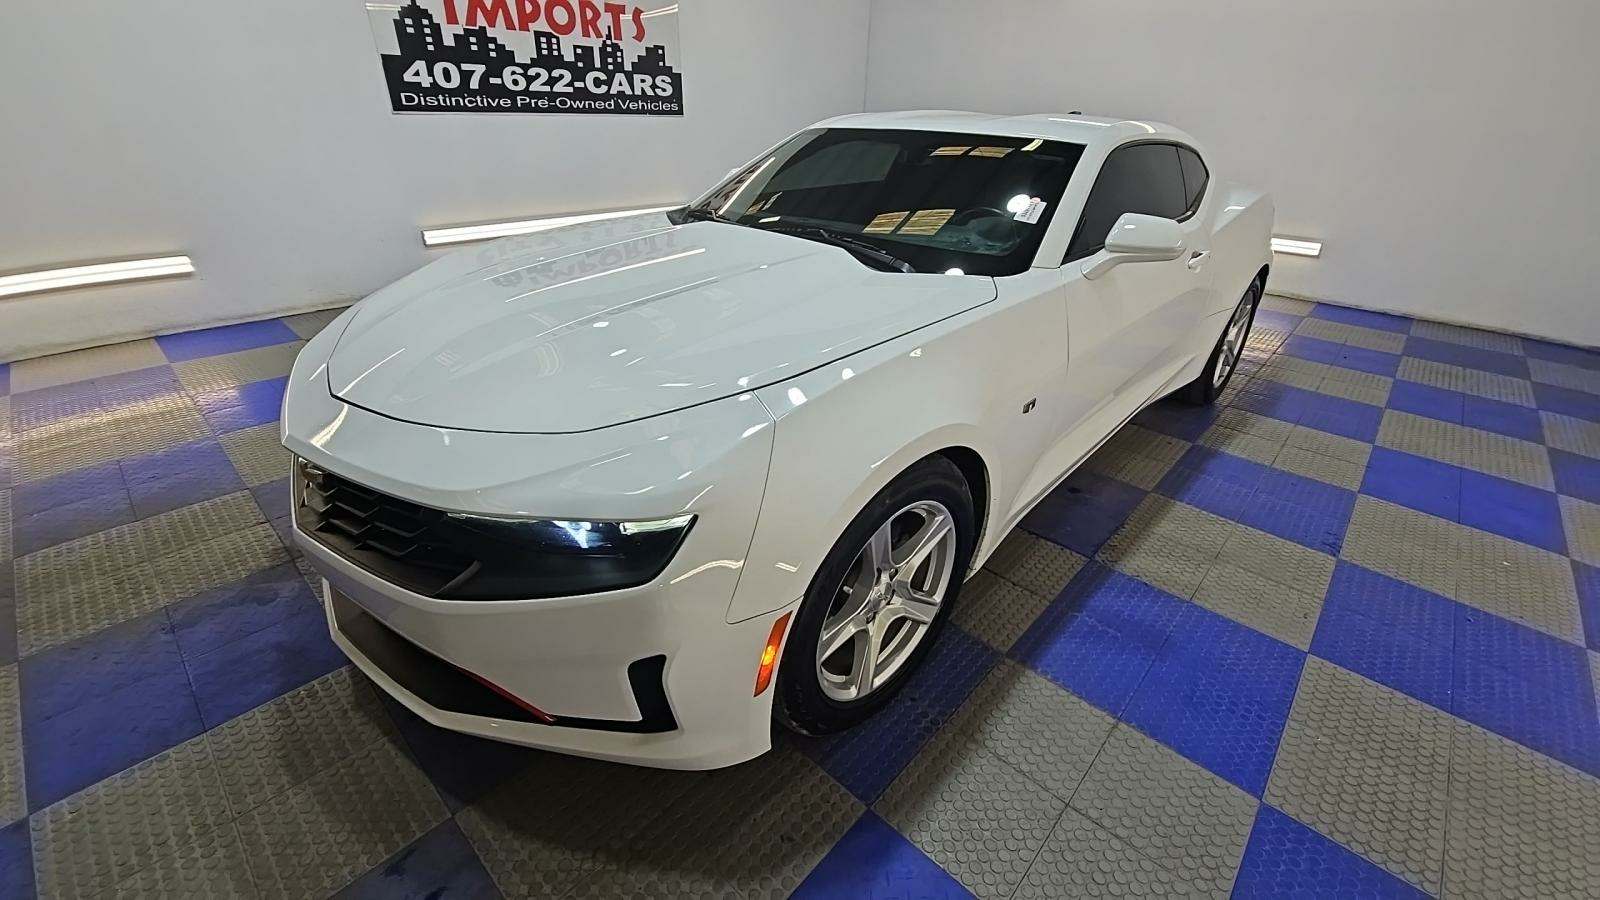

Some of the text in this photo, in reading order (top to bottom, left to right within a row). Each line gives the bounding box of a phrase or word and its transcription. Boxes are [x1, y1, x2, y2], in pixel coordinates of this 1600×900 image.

[444, 0, 646, 42] IMPORTS
[402, 60, 673, 96] 407-622-CARS
[401, 93, 679, 111] Distinctive Pre-Owned Vehicles
